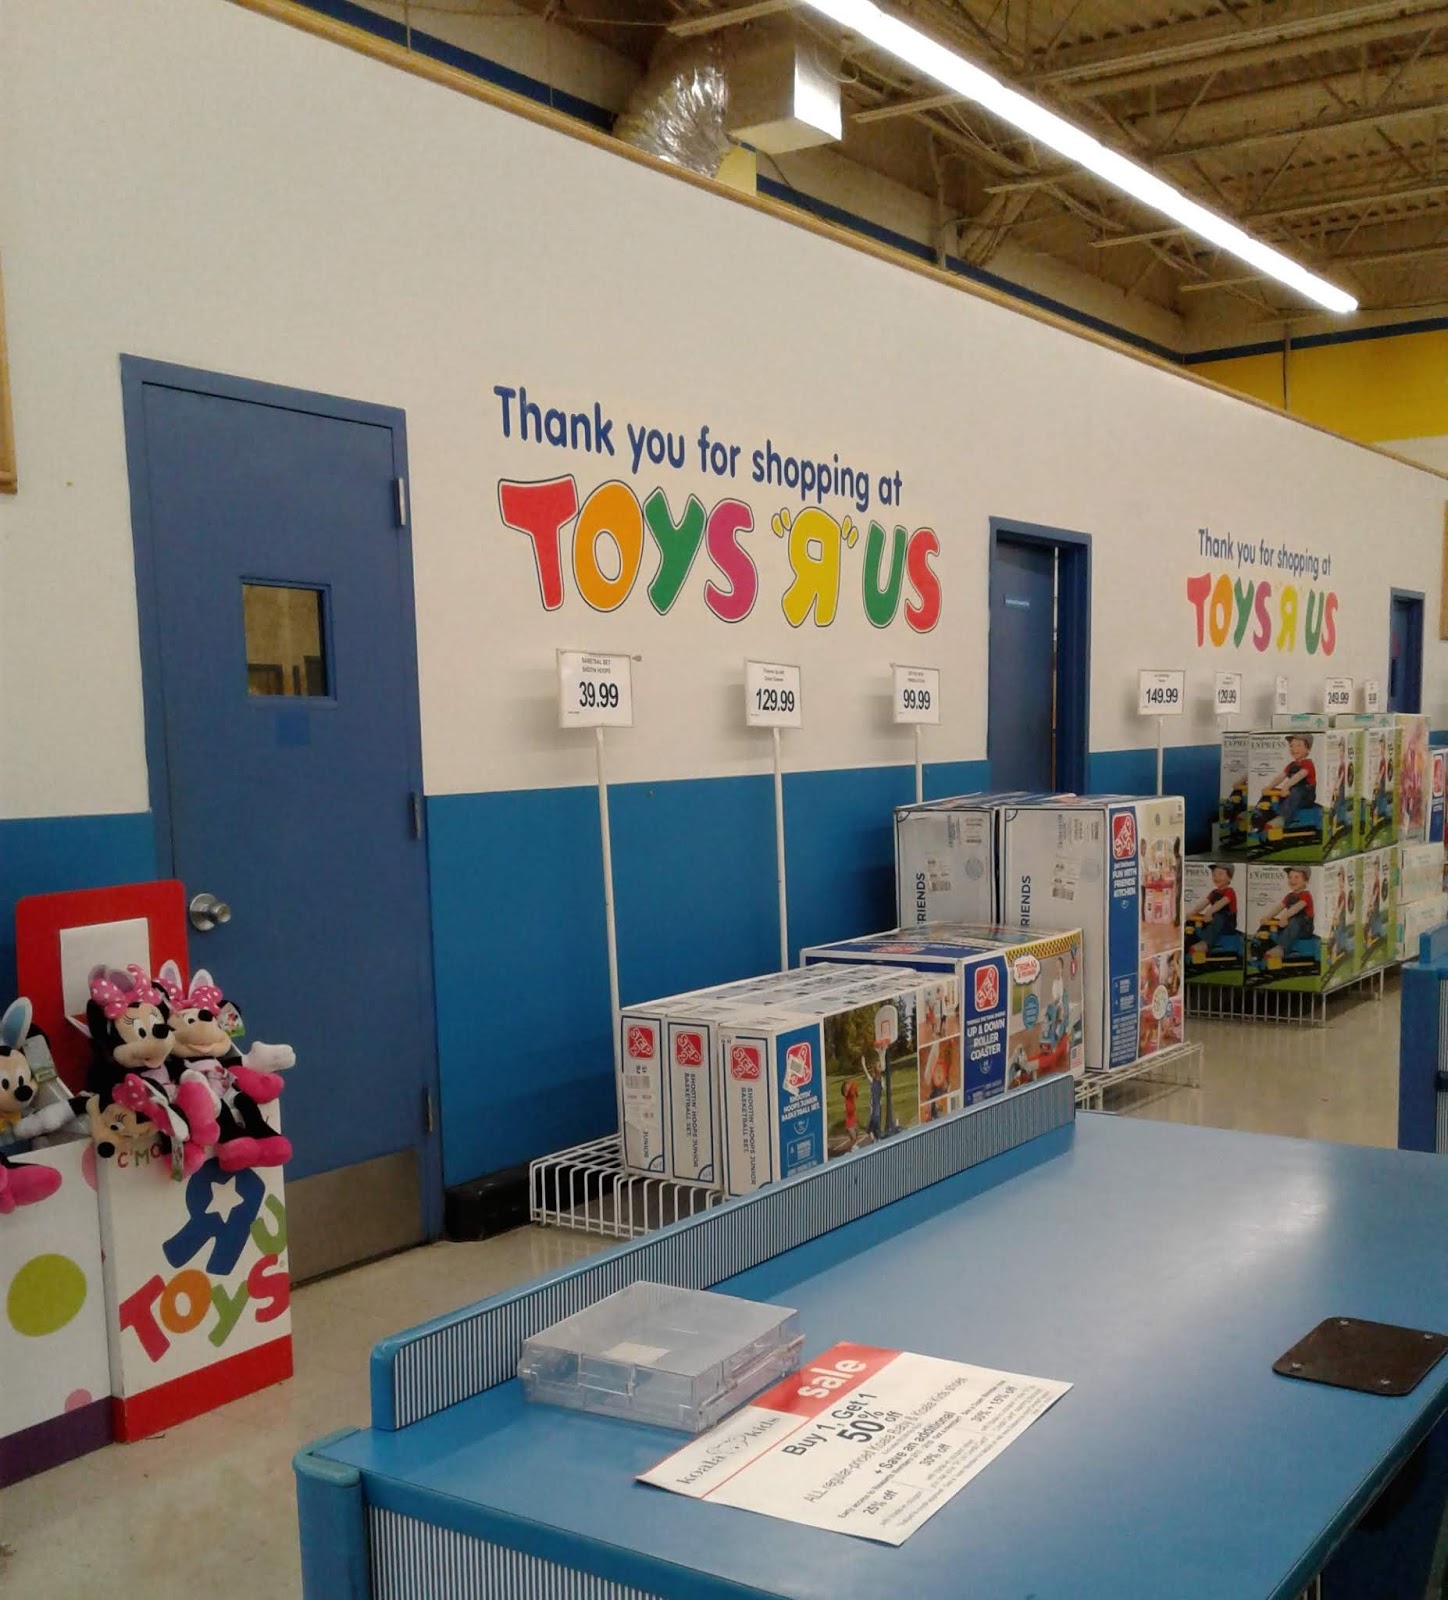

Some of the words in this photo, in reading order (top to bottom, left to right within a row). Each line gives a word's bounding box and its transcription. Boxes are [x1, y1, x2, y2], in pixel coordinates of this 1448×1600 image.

[493, 385, 615, 456] Thank
[627, 422, 685, 474] you
[699, 425, 742, 478] for
[752, 439, 869, 513] shopping
[878, 469, 903, 507] at
[497, 473, 759, 624] TOYS
[861, 520, 942, 634] US
[1198, 527, 1234, 560] Thank
[1237, 540, 1256, 569] you
[1259, 539, 1274, 566] for
[1277, 544, 1319, 581] shopping
[1321, 554, 1332, 576] at
[1186, 572, 1272, 653] TOYS
[1305, 589, 1339, 656] US
[579, 681, 619, 708] 39.99
[756, 688, 795, 712] 129.99
[903, 689, 931, 710] 99.99
[1146, 688, 1178, 704] 149.99
[1251, 741, 1286, 749] EXPRESS
[1020, 875, 1031, 926] RIENDS
[967, 1026, 977, 1037] UP
[984, 1018, 1006, 1032] DOWN
[973, 1032, 999, 1048] ROLLER
[677, 1033, 701, 1062] STEP
[970, 1043, 1001, 1062] COASTER
[733, 1047, 759, 1076] STEP
[797, 1359, 867, 1399] sale
[781, 1433, 827, 1455] Buy
[831, 1400, 867, 1418] Get
[884, 1410, 902, 1422] off
[676, 1452, 726, 1485] koala
[745, 1416, 780, 1438] kids
[878, 1451, 906, 1468] Save
[903, 1442, 918, 1451] an
[914, 1411, 955, 1441] additional
[937, 1443, 950, 1452] off
[804, 1490, 827, 1502] ALL
[862, 1501, 886, 1514] 25%
[882, 1489, 897, 1500] off
